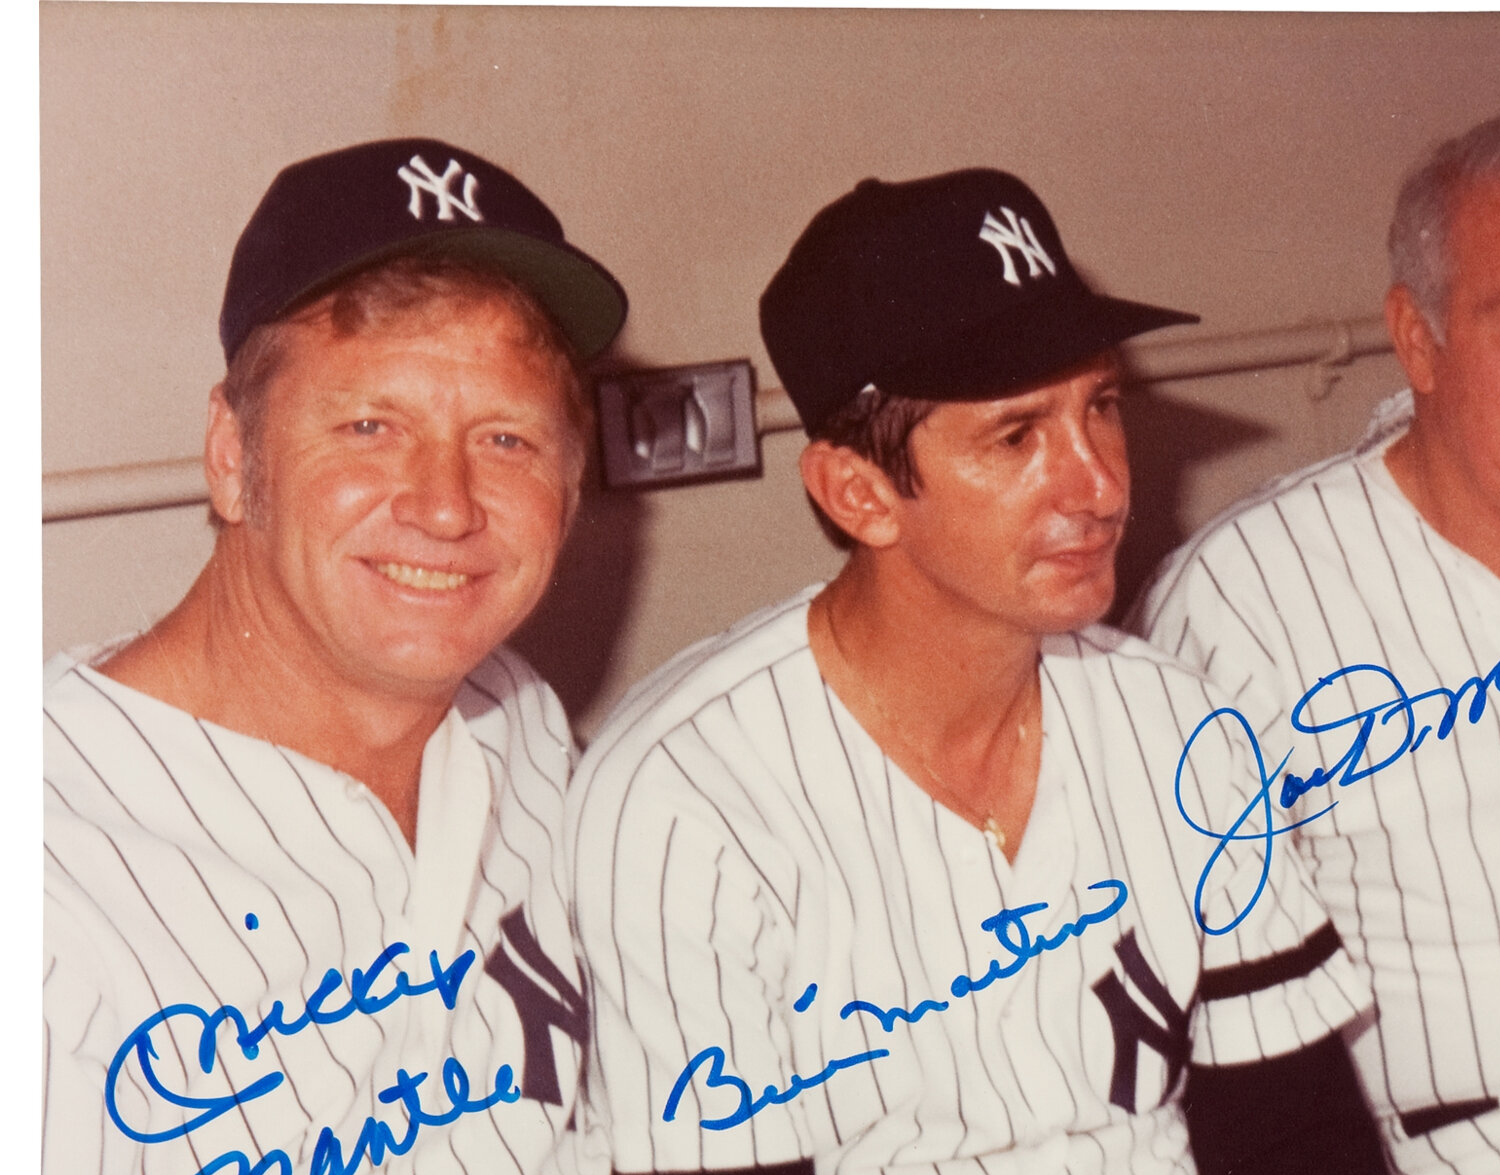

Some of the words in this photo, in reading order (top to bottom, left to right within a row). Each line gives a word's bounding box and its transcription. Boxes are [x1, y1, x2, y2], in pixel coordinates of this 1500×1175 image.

[397, 154, 483, 222] NY
[978, 205, 1057, 287] NY
[839, 879, 1129, 1033] Martin
[104, 912, 477, 1144] Mickey
